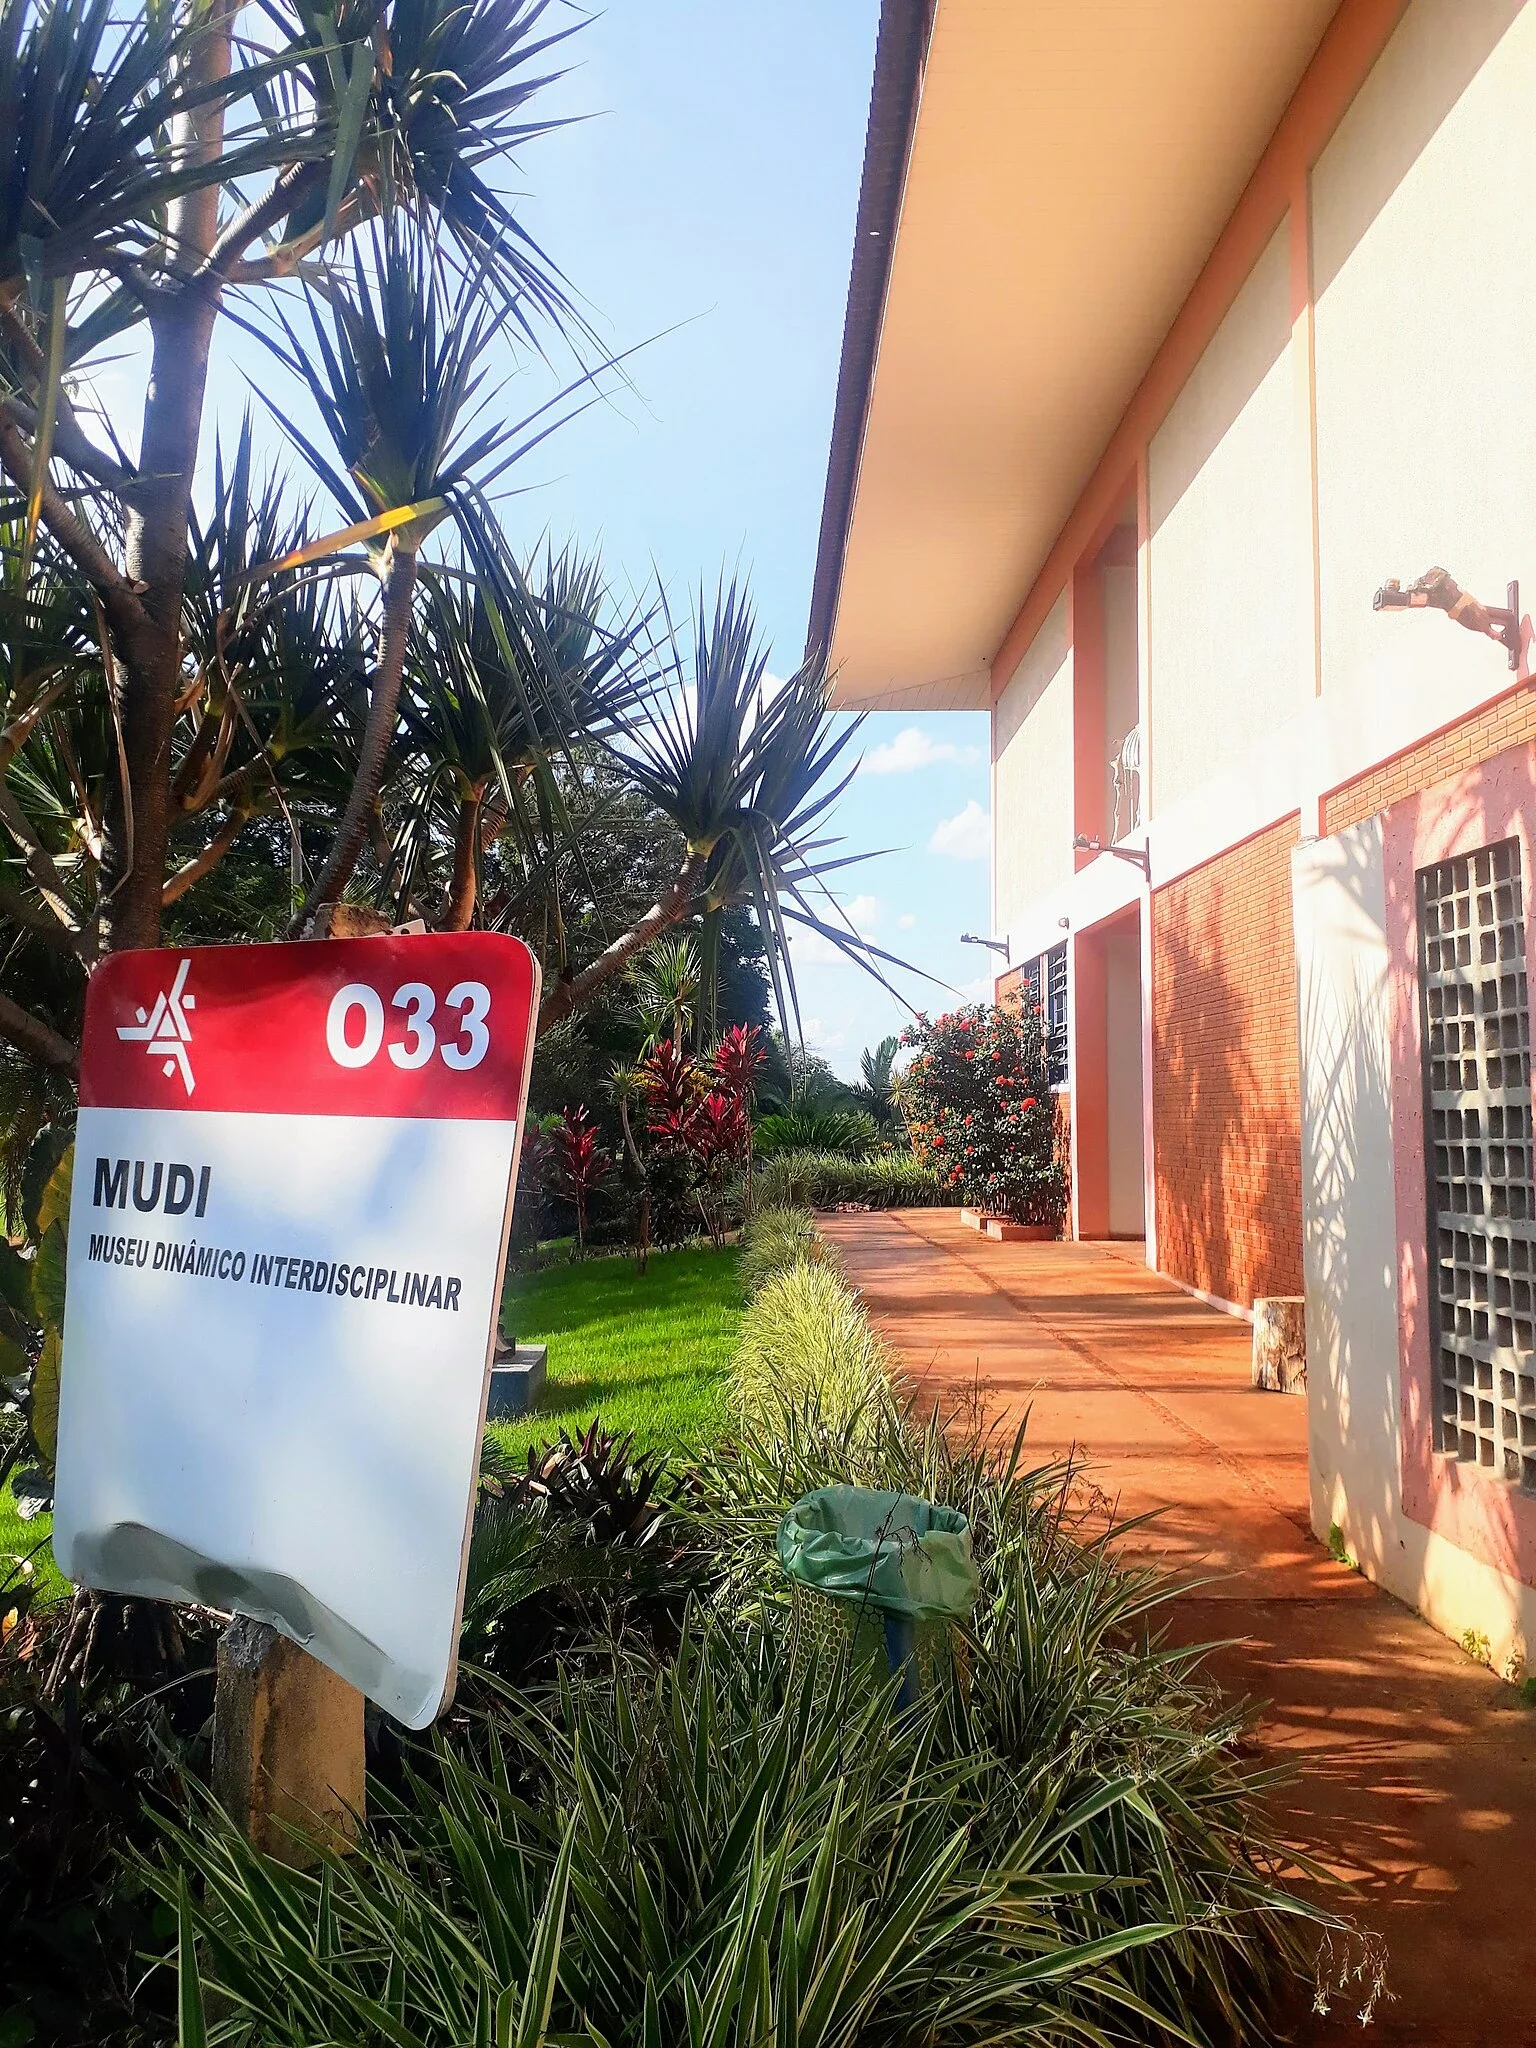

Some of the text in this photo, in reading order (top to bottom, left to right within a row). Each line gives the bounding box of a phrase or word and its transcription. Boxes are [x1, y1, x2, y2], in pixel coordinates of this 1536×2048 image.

[325, 981, 491, 1071] 033
[92, 1156, 211, 1218] MUDI
[88, 1233, 462, 1312] MUSEU DINÂMICO INTERDISCIPLINAR
